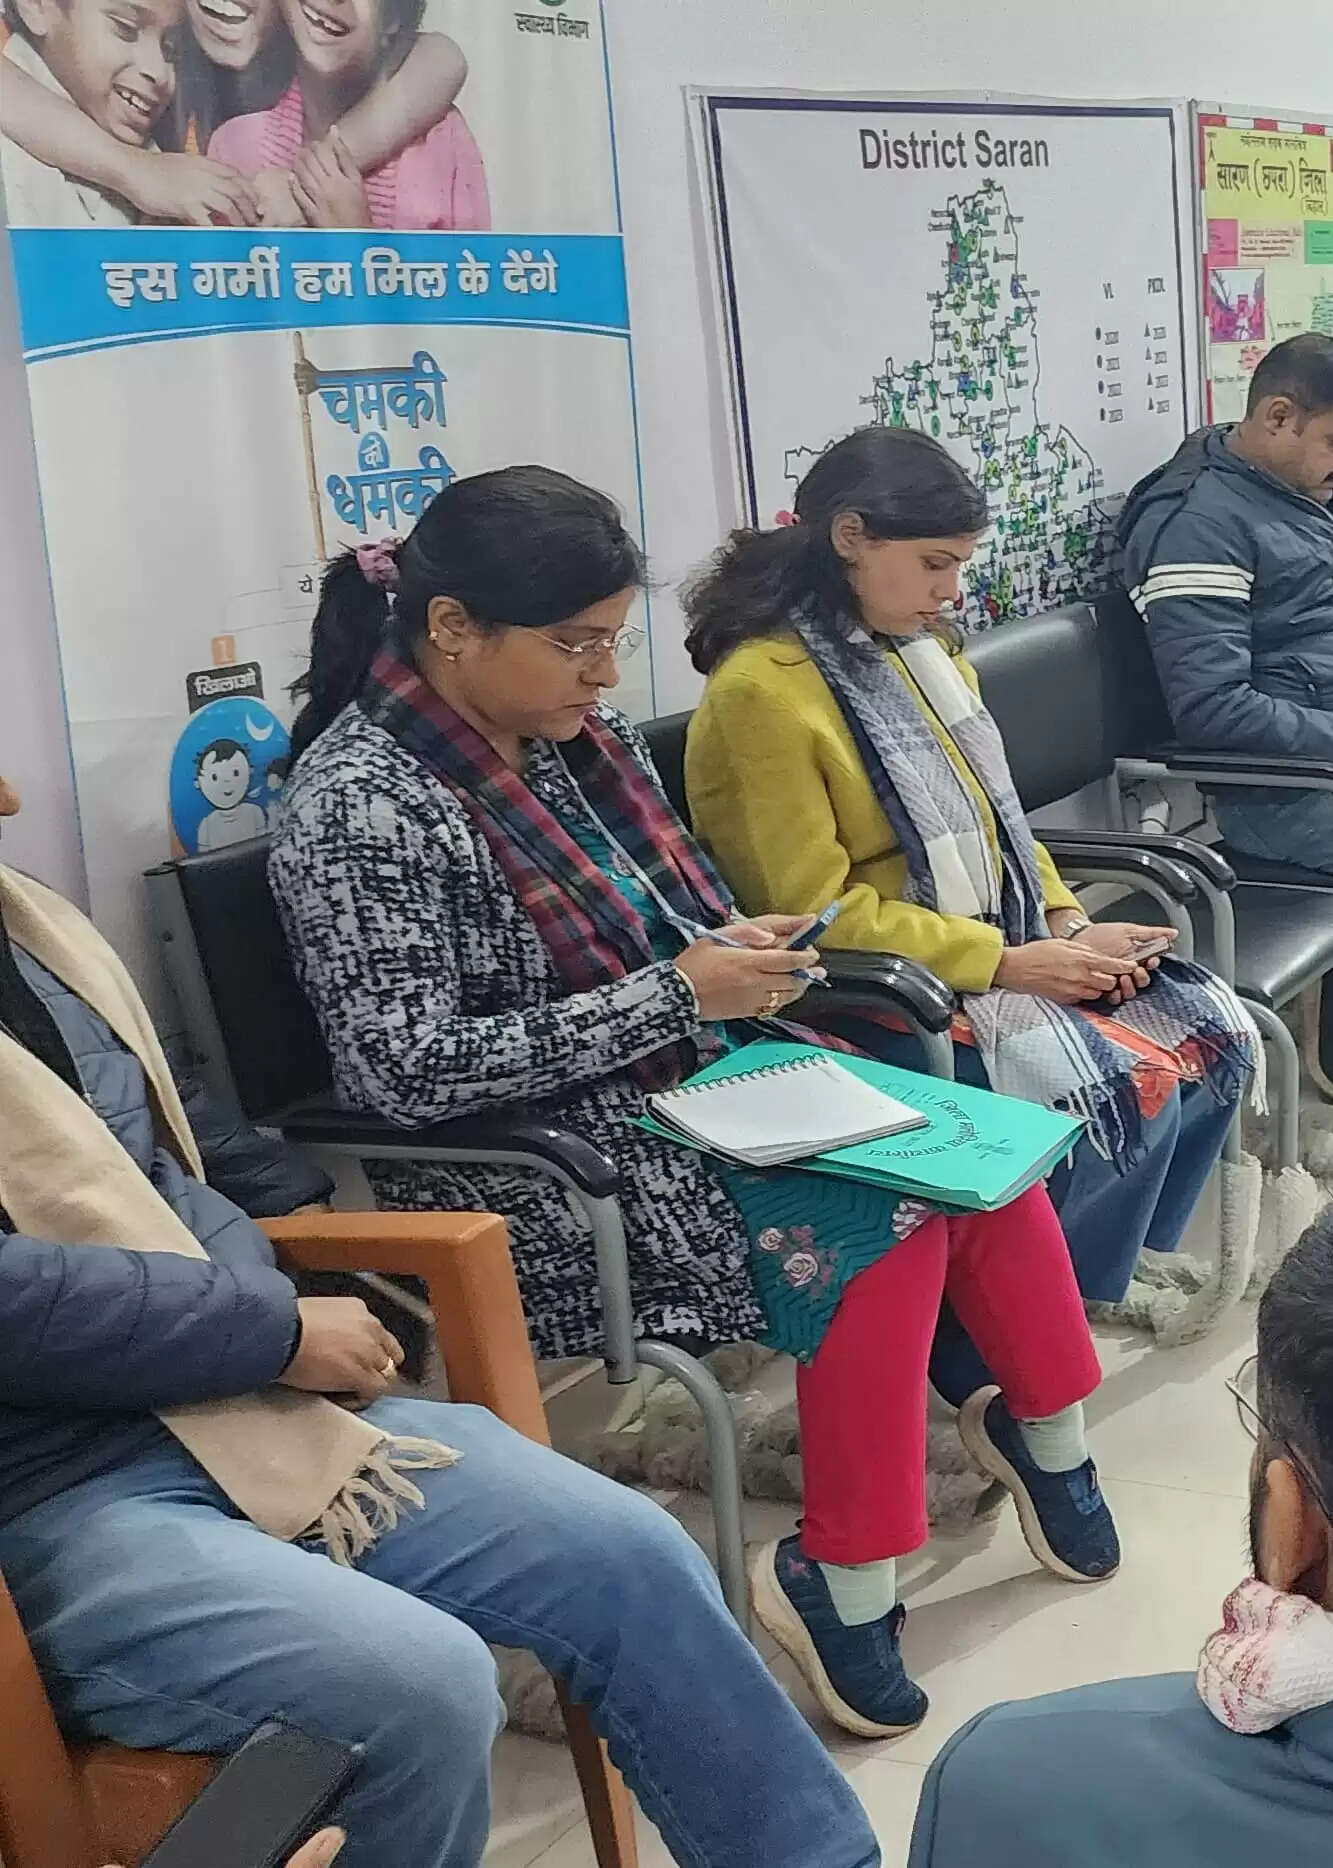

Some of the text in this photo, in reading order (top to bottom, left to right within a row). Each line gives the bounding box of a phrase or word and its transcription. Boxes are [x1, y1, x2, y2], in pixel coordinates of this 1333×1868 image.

[859, 128, 1049, 170] District Saran
[101, 246, 559, 308] इस गर्मी हम मिल के देंगे
[318, 351, 449, 434] चमकी
[194, 667, 257, 697] खिलाओ
